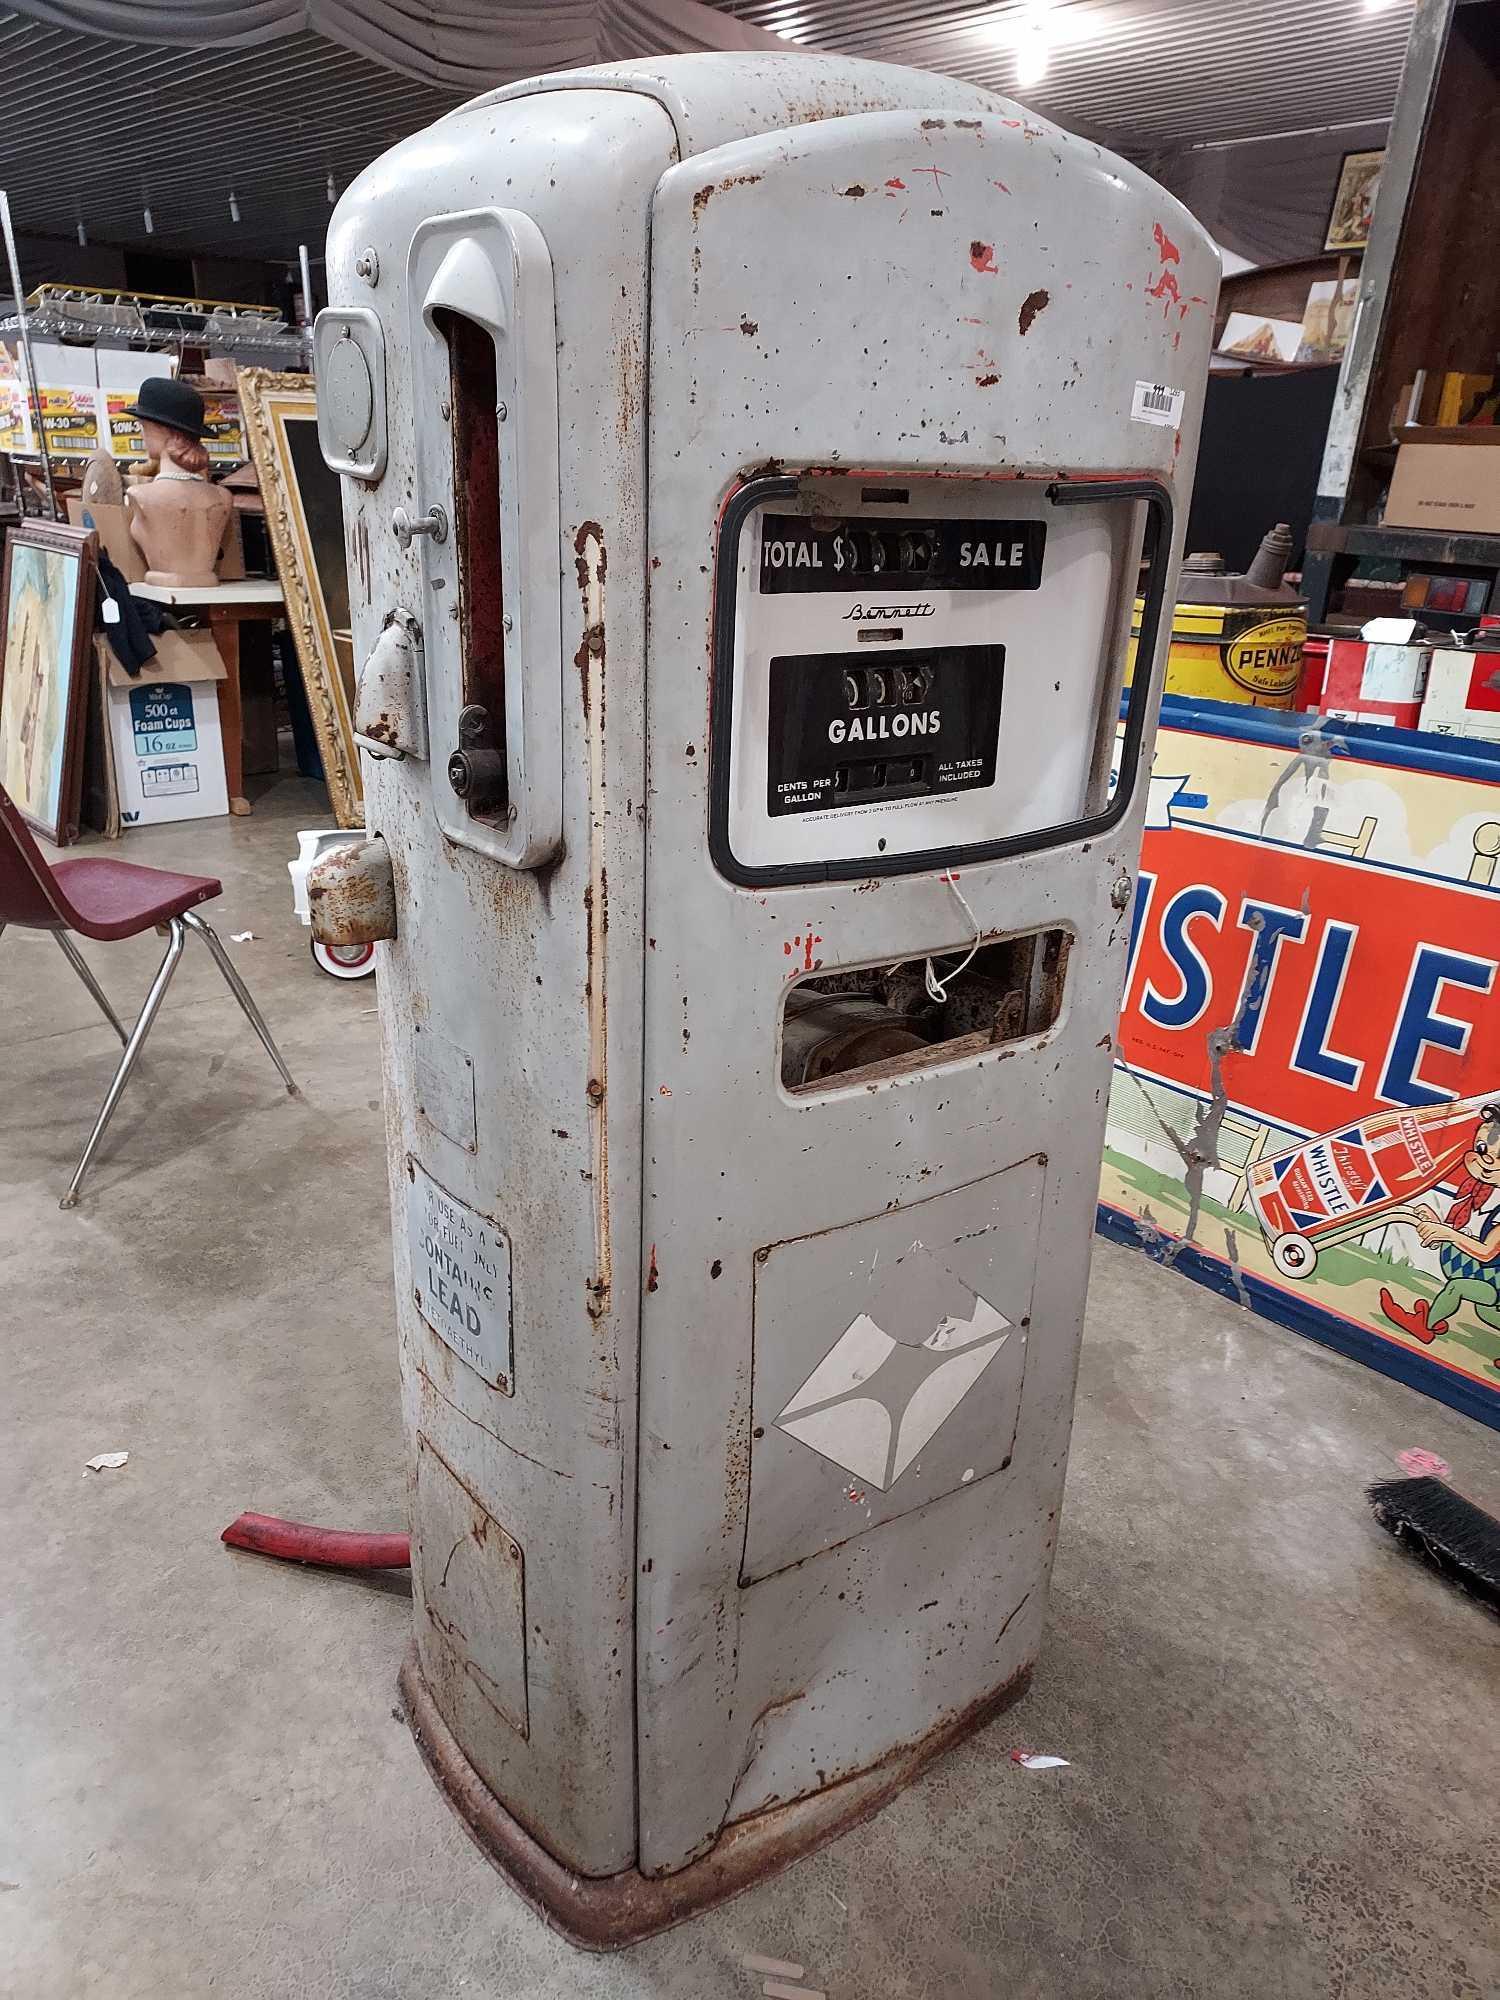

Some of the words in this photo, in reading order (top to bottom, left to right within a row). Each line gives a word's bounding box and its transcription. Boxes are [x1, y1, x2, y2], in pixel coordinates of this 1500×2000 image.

[763, 541, 823, 568] TOTAL
[833, 535, 845, 573] $
[959, 542, 1024, 567] SALE
[842, 603, 936, 621] Bennett
[1238, 644, 1301, 669] PENNZ
[144, 703, 168, 718] 500
[169, 706, 178, 715] ct
[135, 720, 163, 732] Foam
[165, 717, 192, 730] Cups
[828, 710, 941, 744] GALLONS
[144, 735, 163, 753] 16
[938, 762, 953, 772] ALL
[955, 758, 983, 769] TAXES
[939, 770, 981, 782] INCLUDED
[777, 781, 807, 793] CENTS
[813, 778, 831, 788] PER
[784, 791, 822, 804] GALLON
[1401, 1115, 1434, 1173] WHISTLE
[1309, 1144, 1350, 1214] WHISTLE
[437, 1198, 455, 1225] USE
[460, 1216, 473, 1238] AS
[428, 1265, 481, 1337] LEAD
